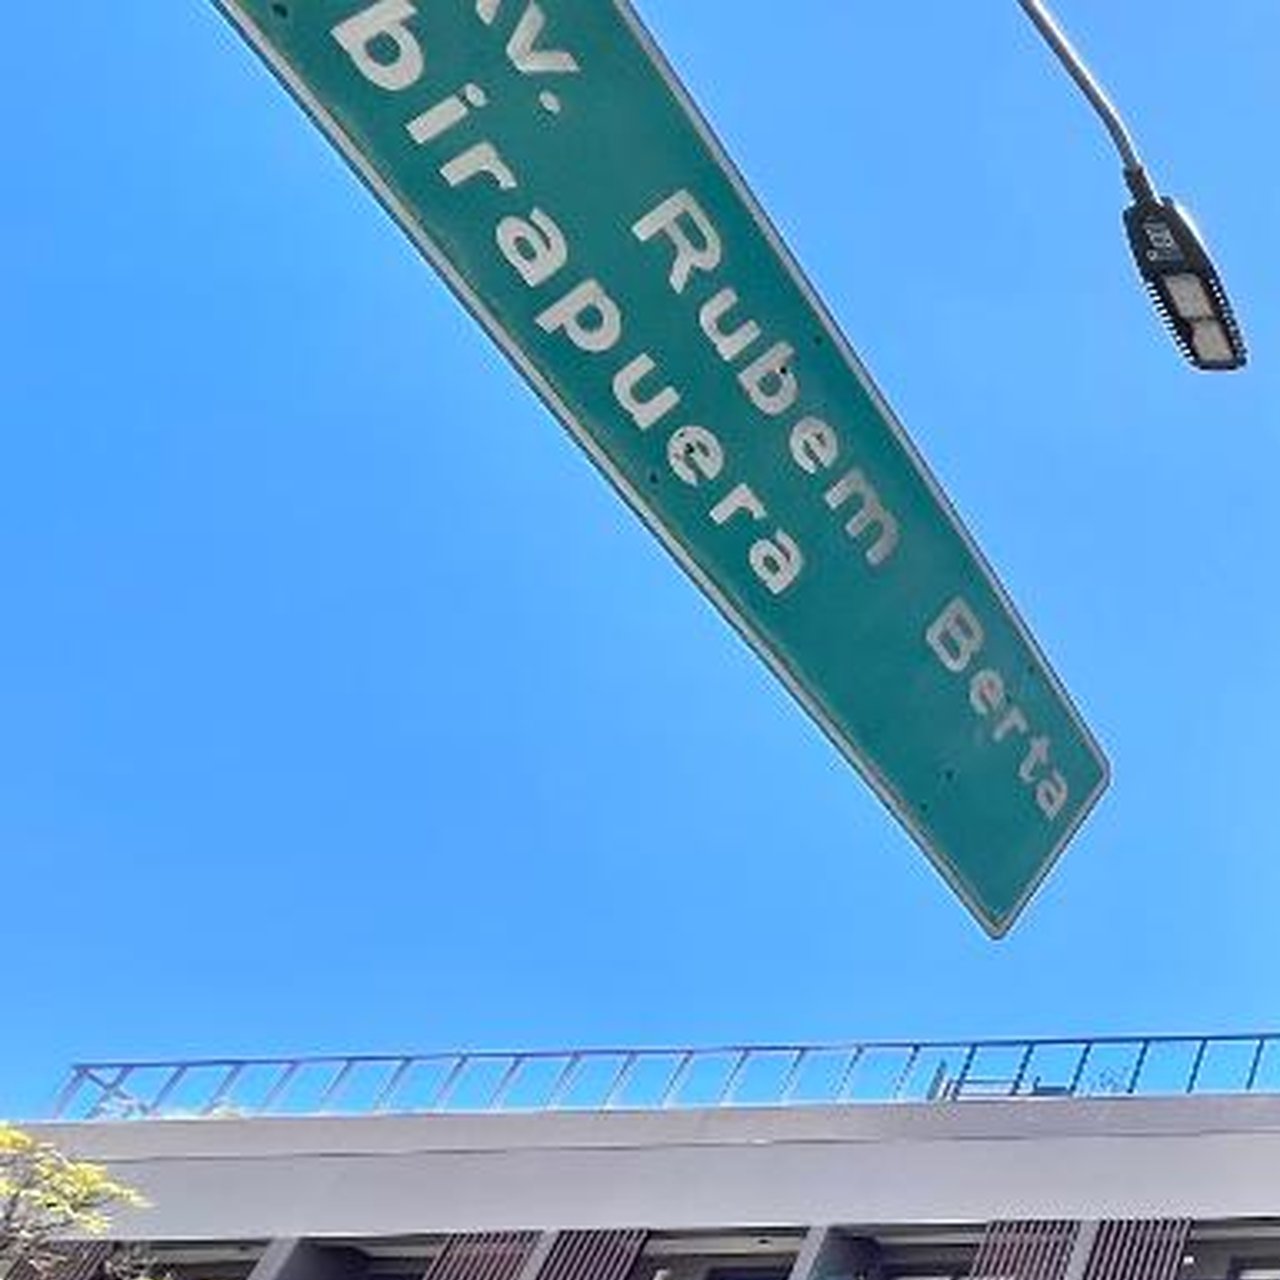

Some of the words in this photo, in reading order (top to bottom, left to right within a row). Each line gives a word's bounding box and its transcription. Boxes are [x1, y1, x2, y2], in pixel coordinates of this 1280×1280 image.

[475, 0, 580, 114] v.
[631, 189, 898, 564] Rubem
[926, 601, 1069, 819] Berta
